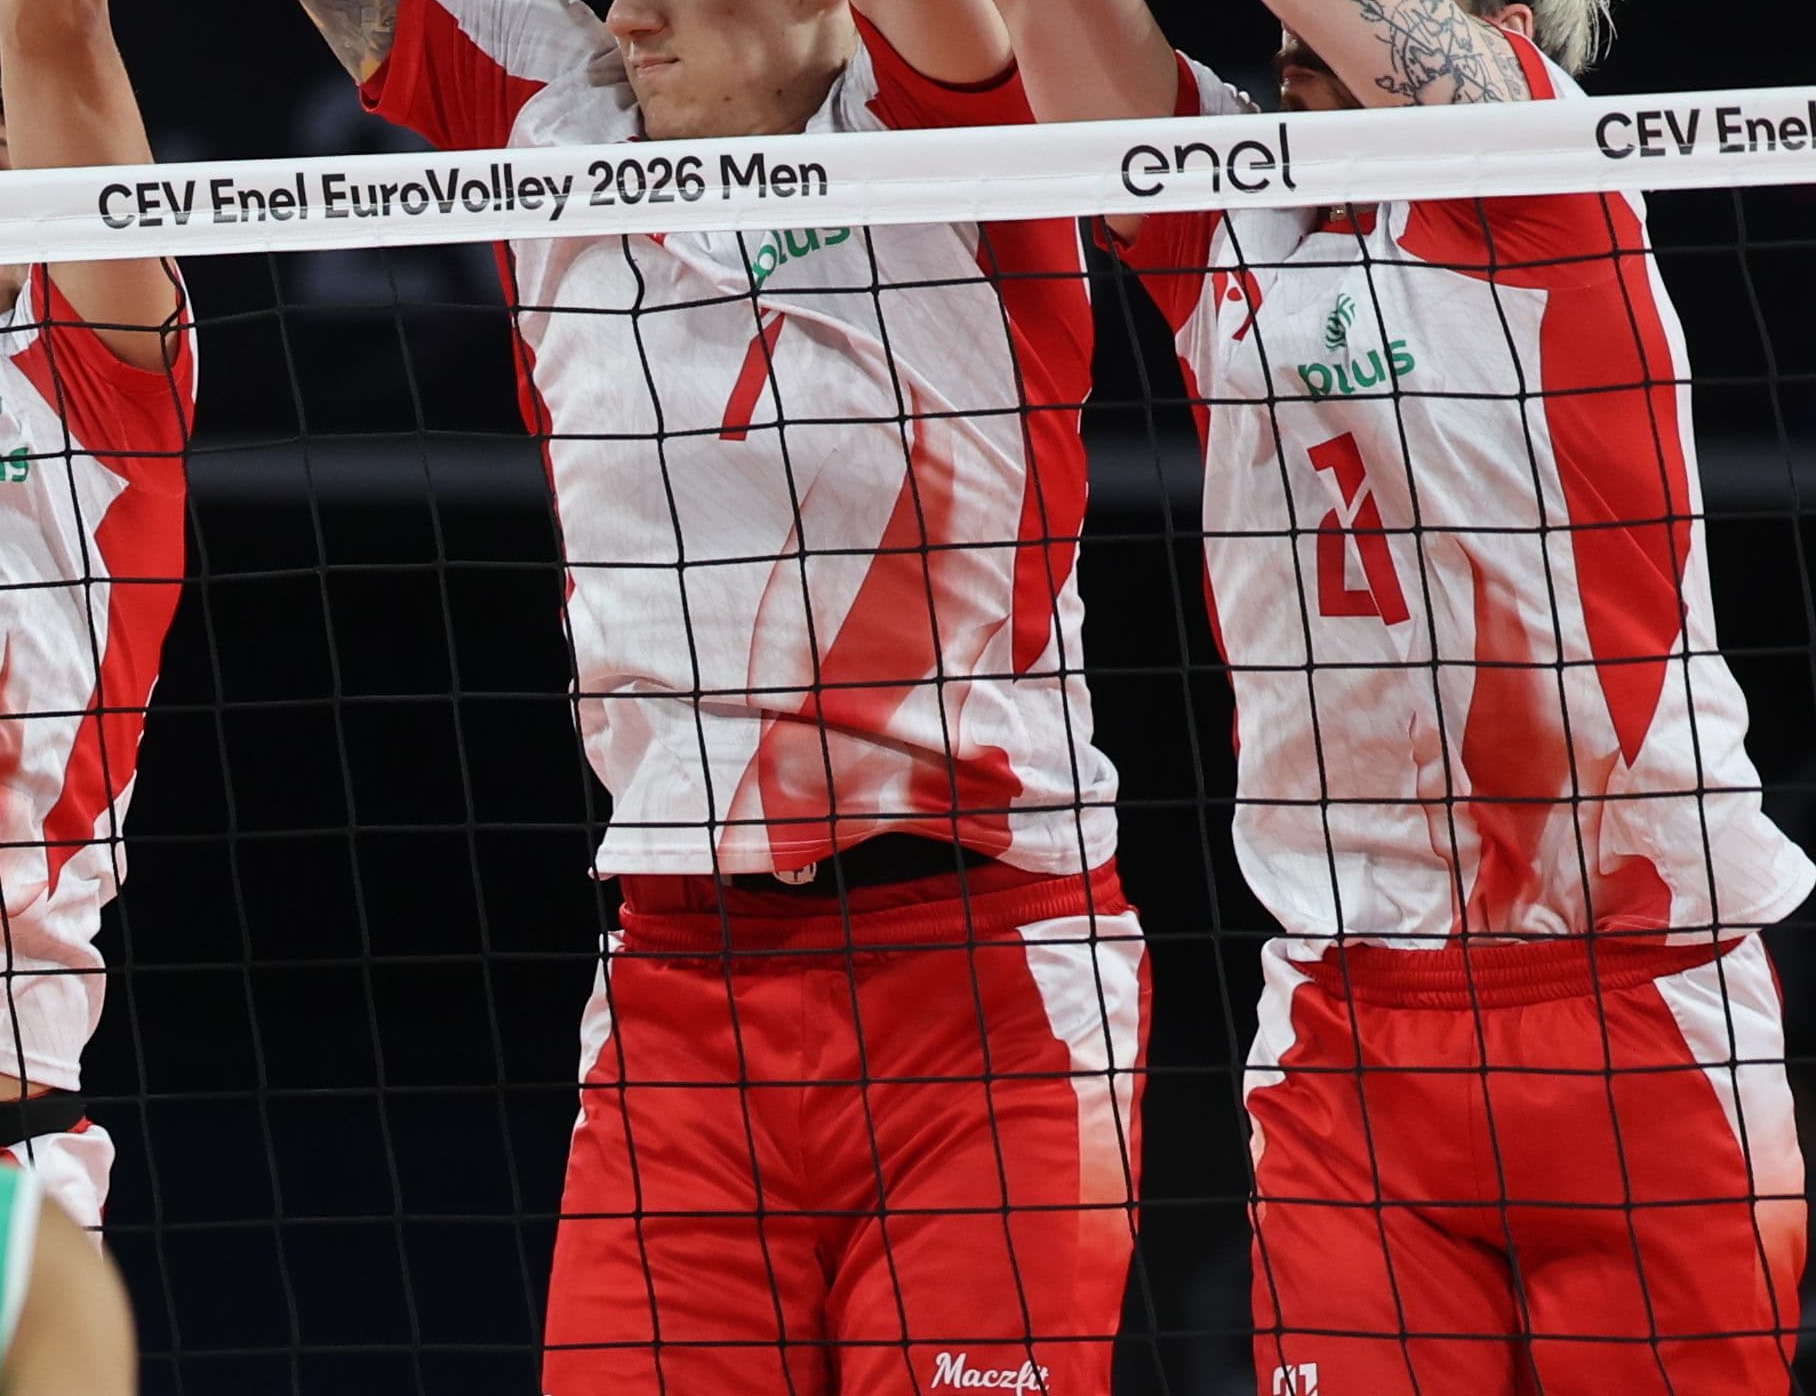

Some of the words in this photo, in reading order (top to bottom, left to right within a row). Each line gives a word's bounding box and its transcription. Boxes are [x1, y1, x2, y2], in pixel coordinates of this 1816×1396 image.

[1121, 122, 1296, 197] enel
[1595, 108, 1700, 159] CEV
[1716, 99, 1816, 153] Enel
[99, 180, 195, 229] CEV
[210, 172, 308, 223] Enel
[322, 163, 573, 221] EuroVolley
[588, 156, 705, 206] 2026
[720, 152, 827, 200] Men
